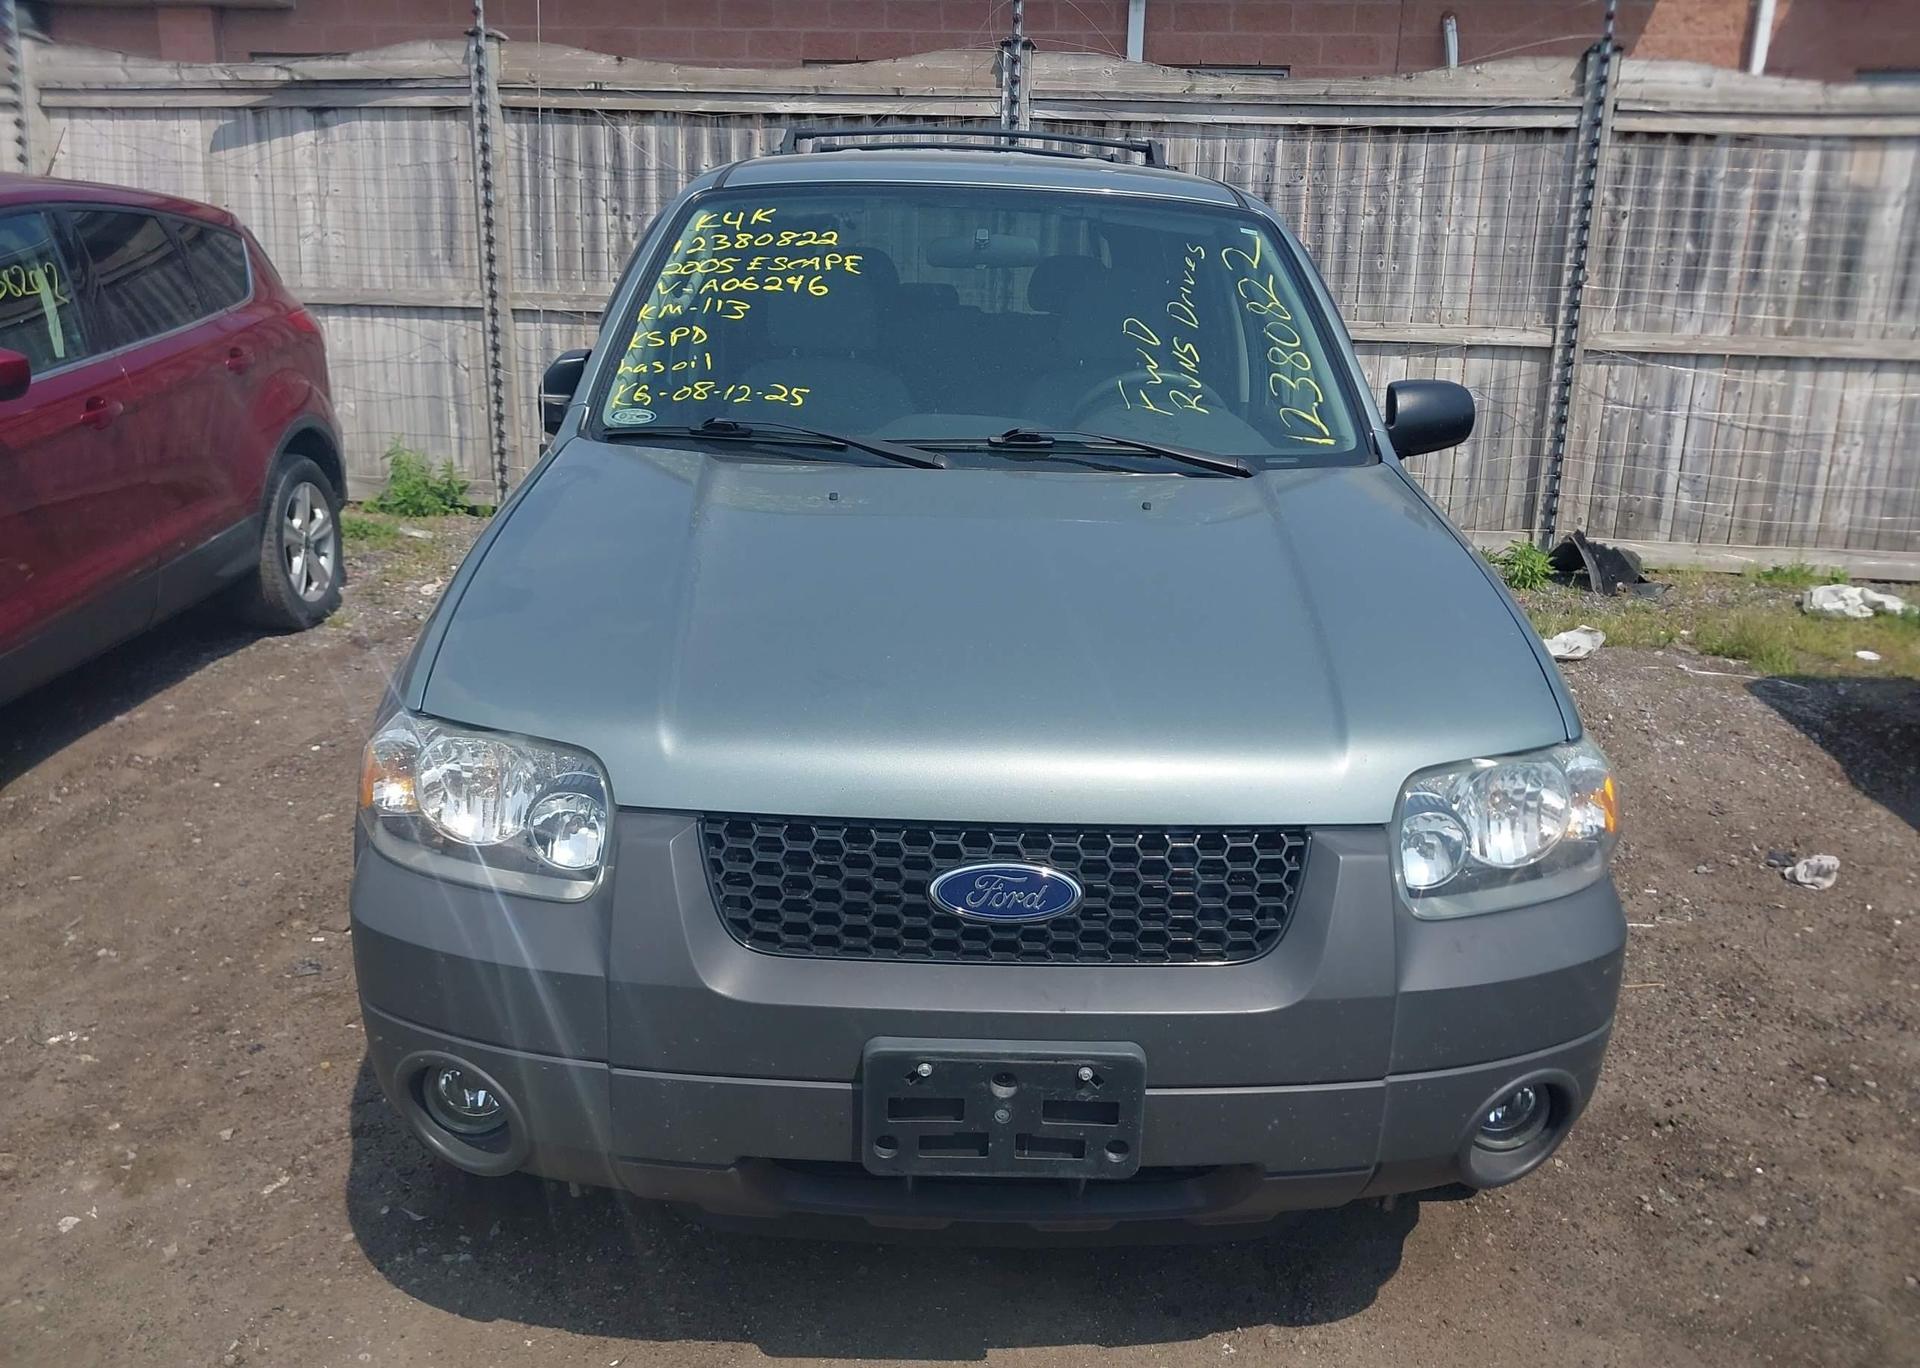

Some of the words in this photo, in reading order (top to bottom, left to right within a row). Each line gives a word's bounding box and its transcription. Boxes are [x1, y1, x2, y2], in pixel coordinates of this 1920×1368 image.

[695, 208, 777, 232] K4K
[673, 230, 838, 254] 12380822
[660, 257, 742, 276] 2005
[746, 253, 863, 275] ESCAPE
[1166, 242, 1206, 330] Drives
[637, 296, 751, 322] KM-113
[1221, 235, 1336, 446] 12380822
[617, 358, 665, 374] has
[671, 352, 712, 371] oil
[965, 873, 1050, 911] Ford
